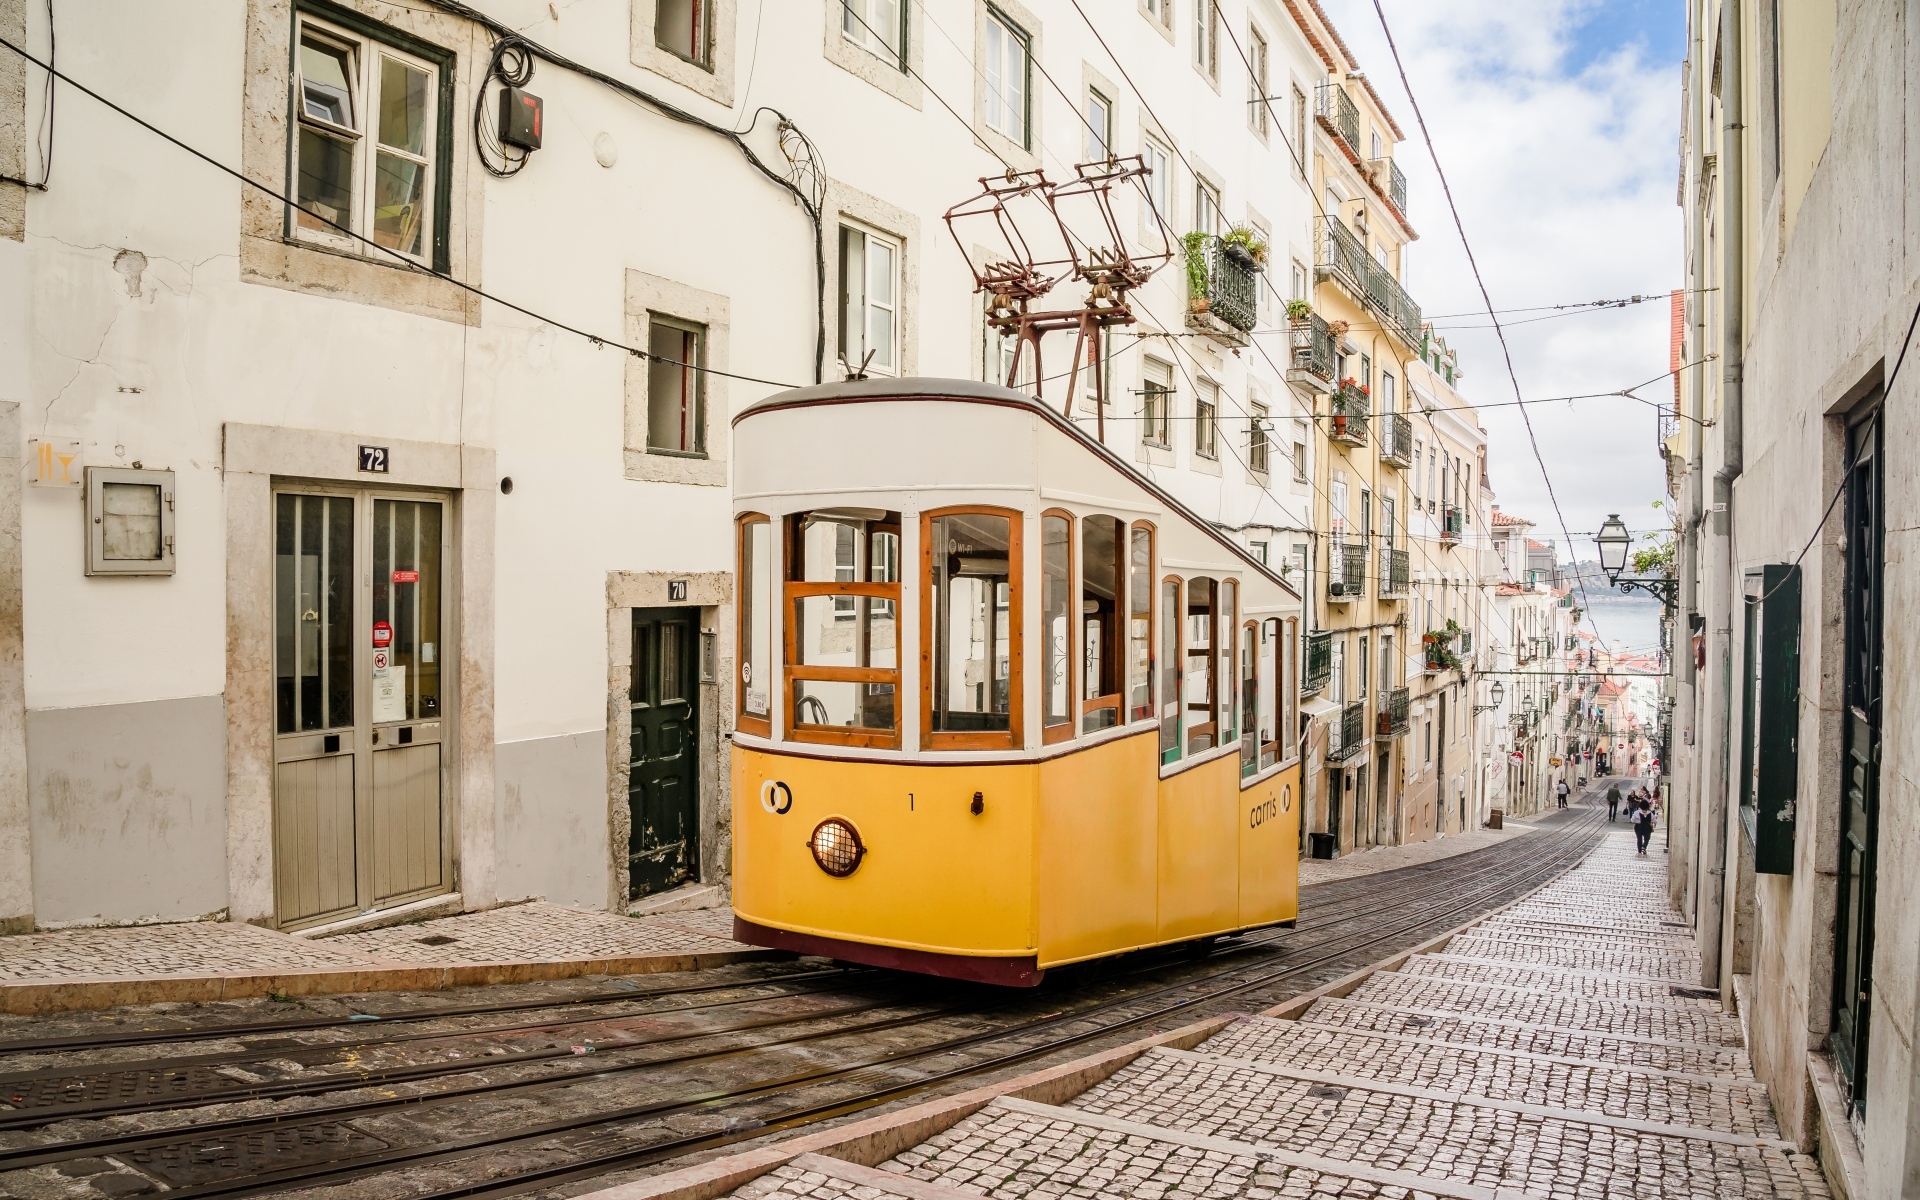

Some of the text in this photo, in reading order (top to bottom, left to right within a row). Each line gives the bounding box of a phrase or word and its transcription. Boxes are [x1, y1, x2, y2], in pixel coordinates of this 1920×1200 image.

[364, 448, 384, 471] 72
[672, 582, 685, 600] 70
[908, 793, 914, 811] 1
[1250, 791, 1277, 829] carris
